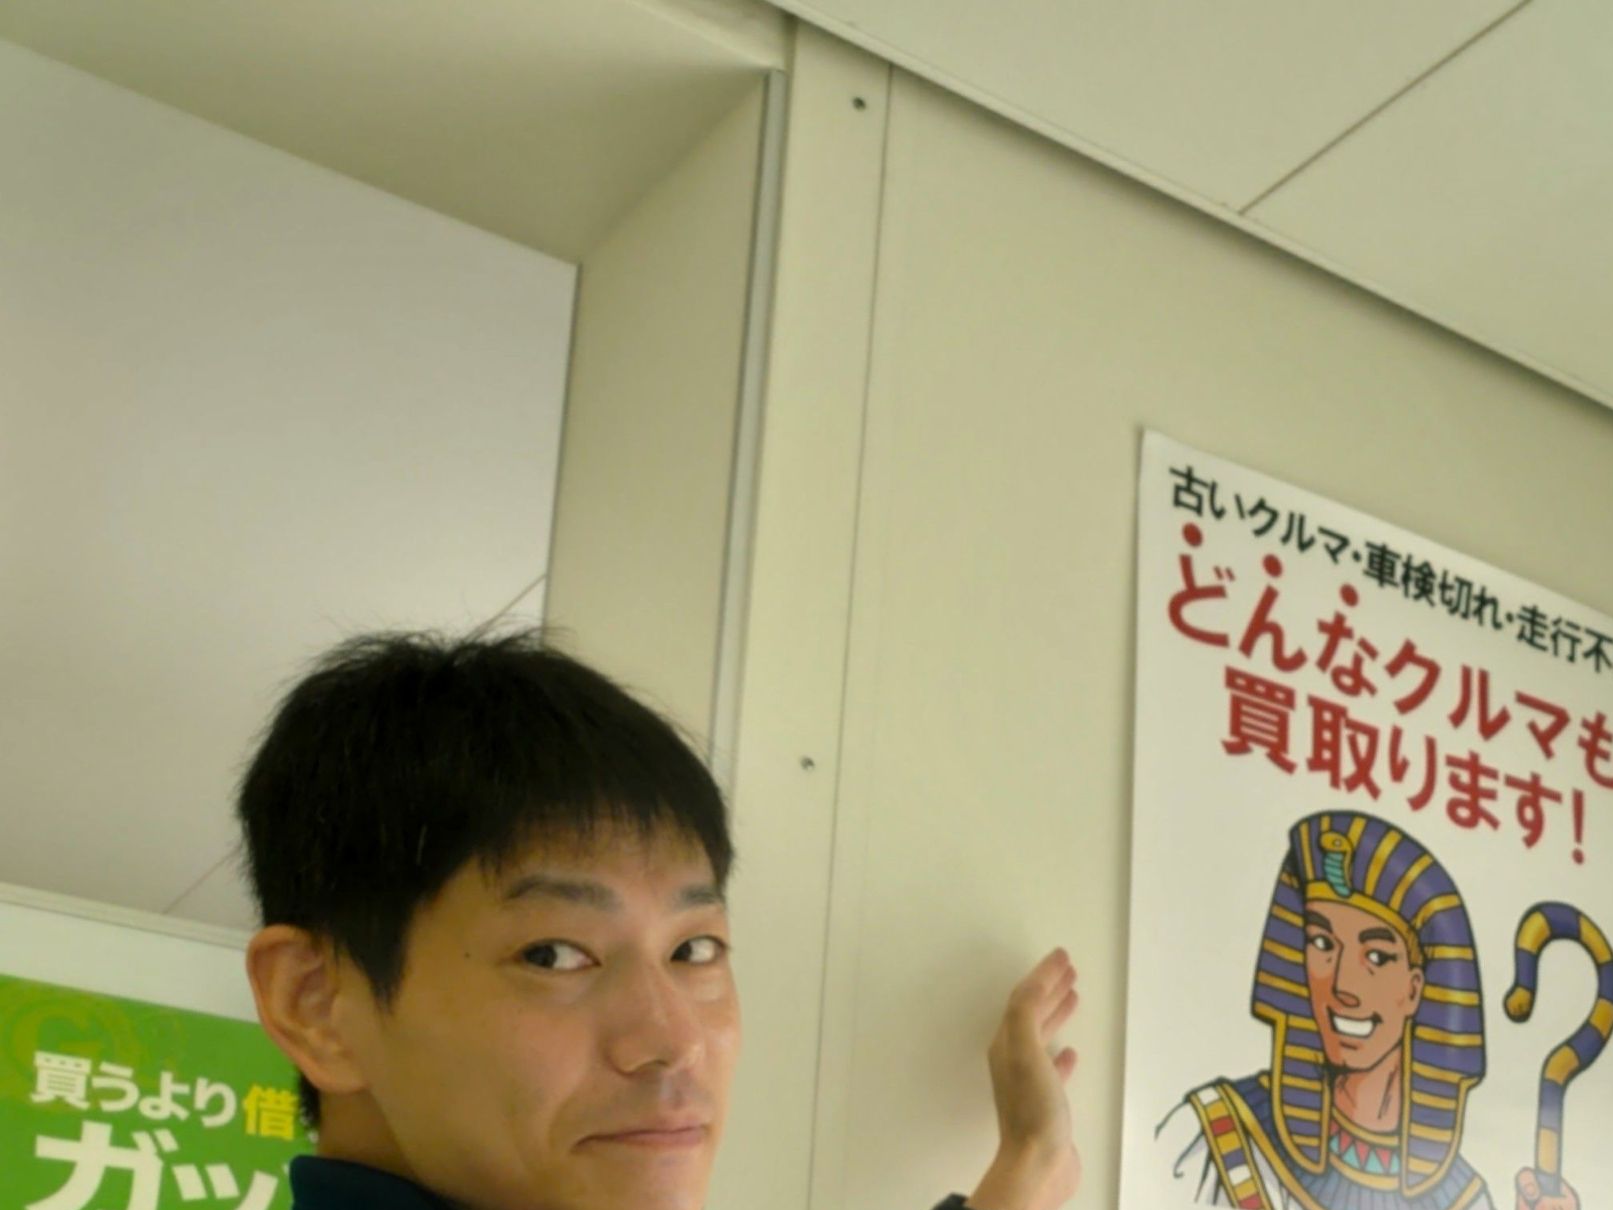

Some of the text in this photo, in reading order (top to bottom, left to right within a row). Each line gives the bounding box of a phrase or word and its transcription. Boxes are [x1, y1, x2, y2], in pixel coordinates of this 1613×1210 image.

[29, 1050, 318, 1144] 買うより借
